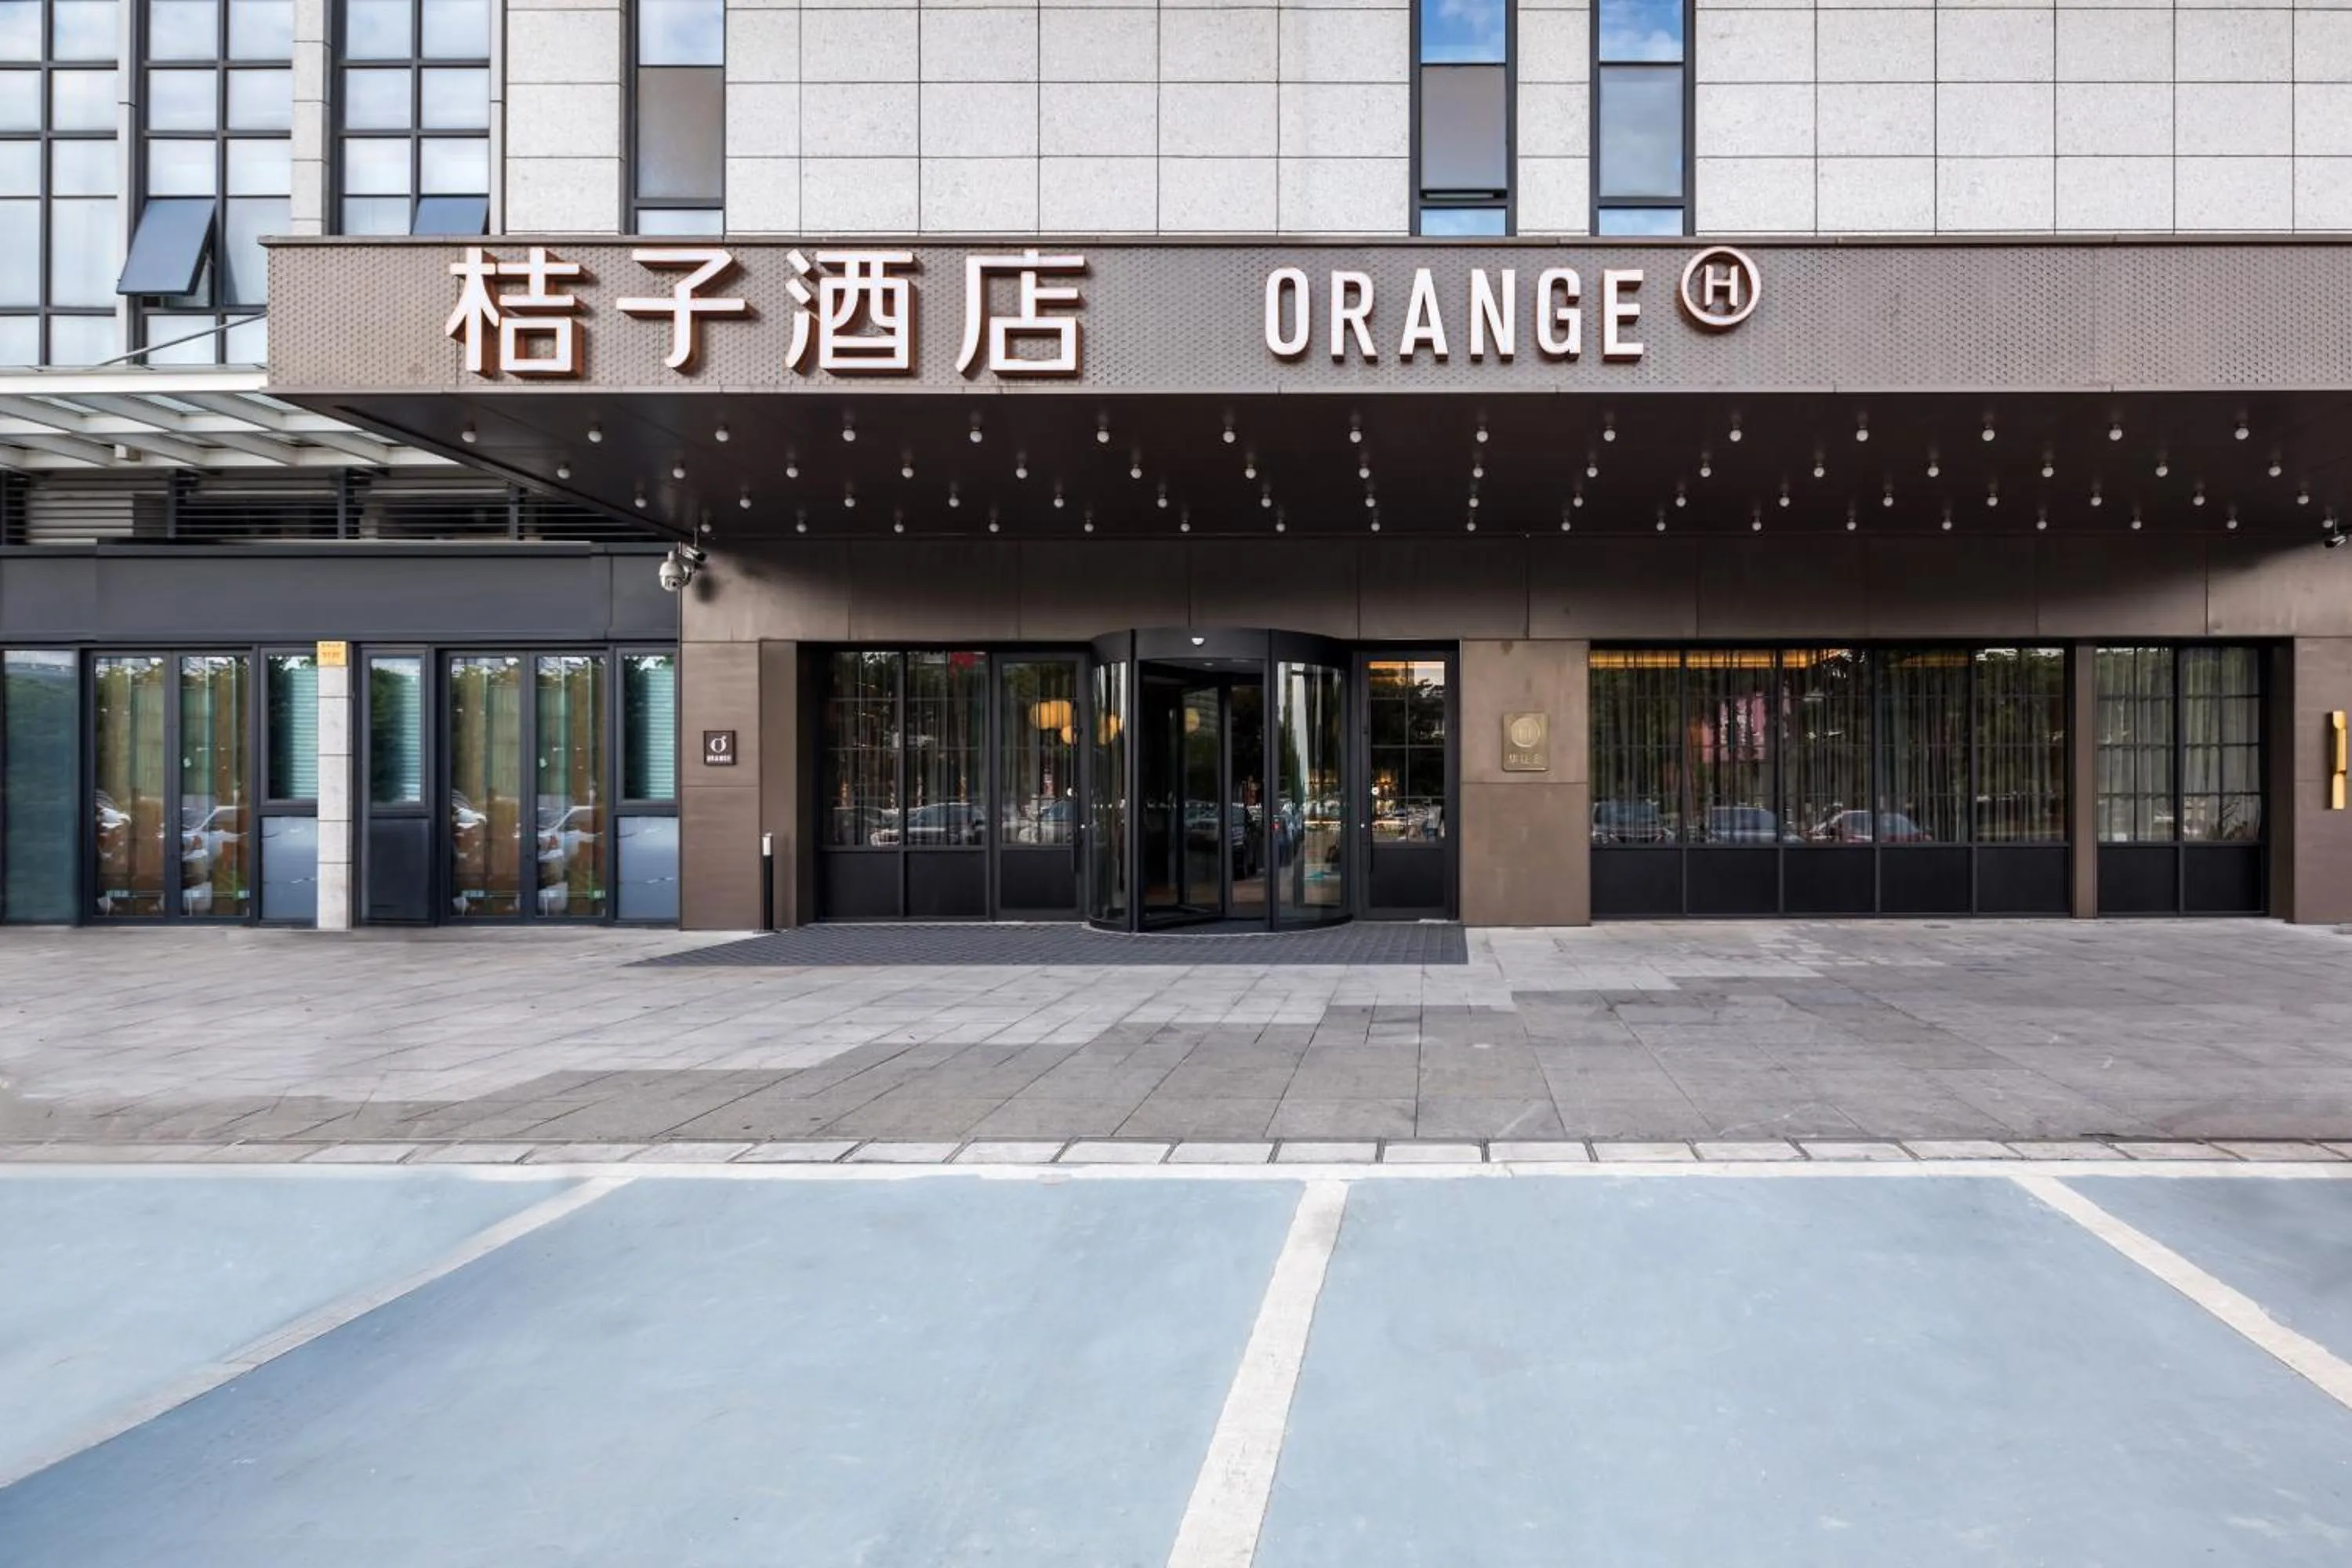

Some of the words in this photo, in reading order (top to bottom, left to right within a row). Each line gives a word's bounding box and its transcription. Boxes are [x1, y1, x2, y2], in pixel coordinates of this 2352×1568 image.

[445, 246, 1087, 375] 桔子酒店
[1264, 267, 1646, 359] ORANGE
